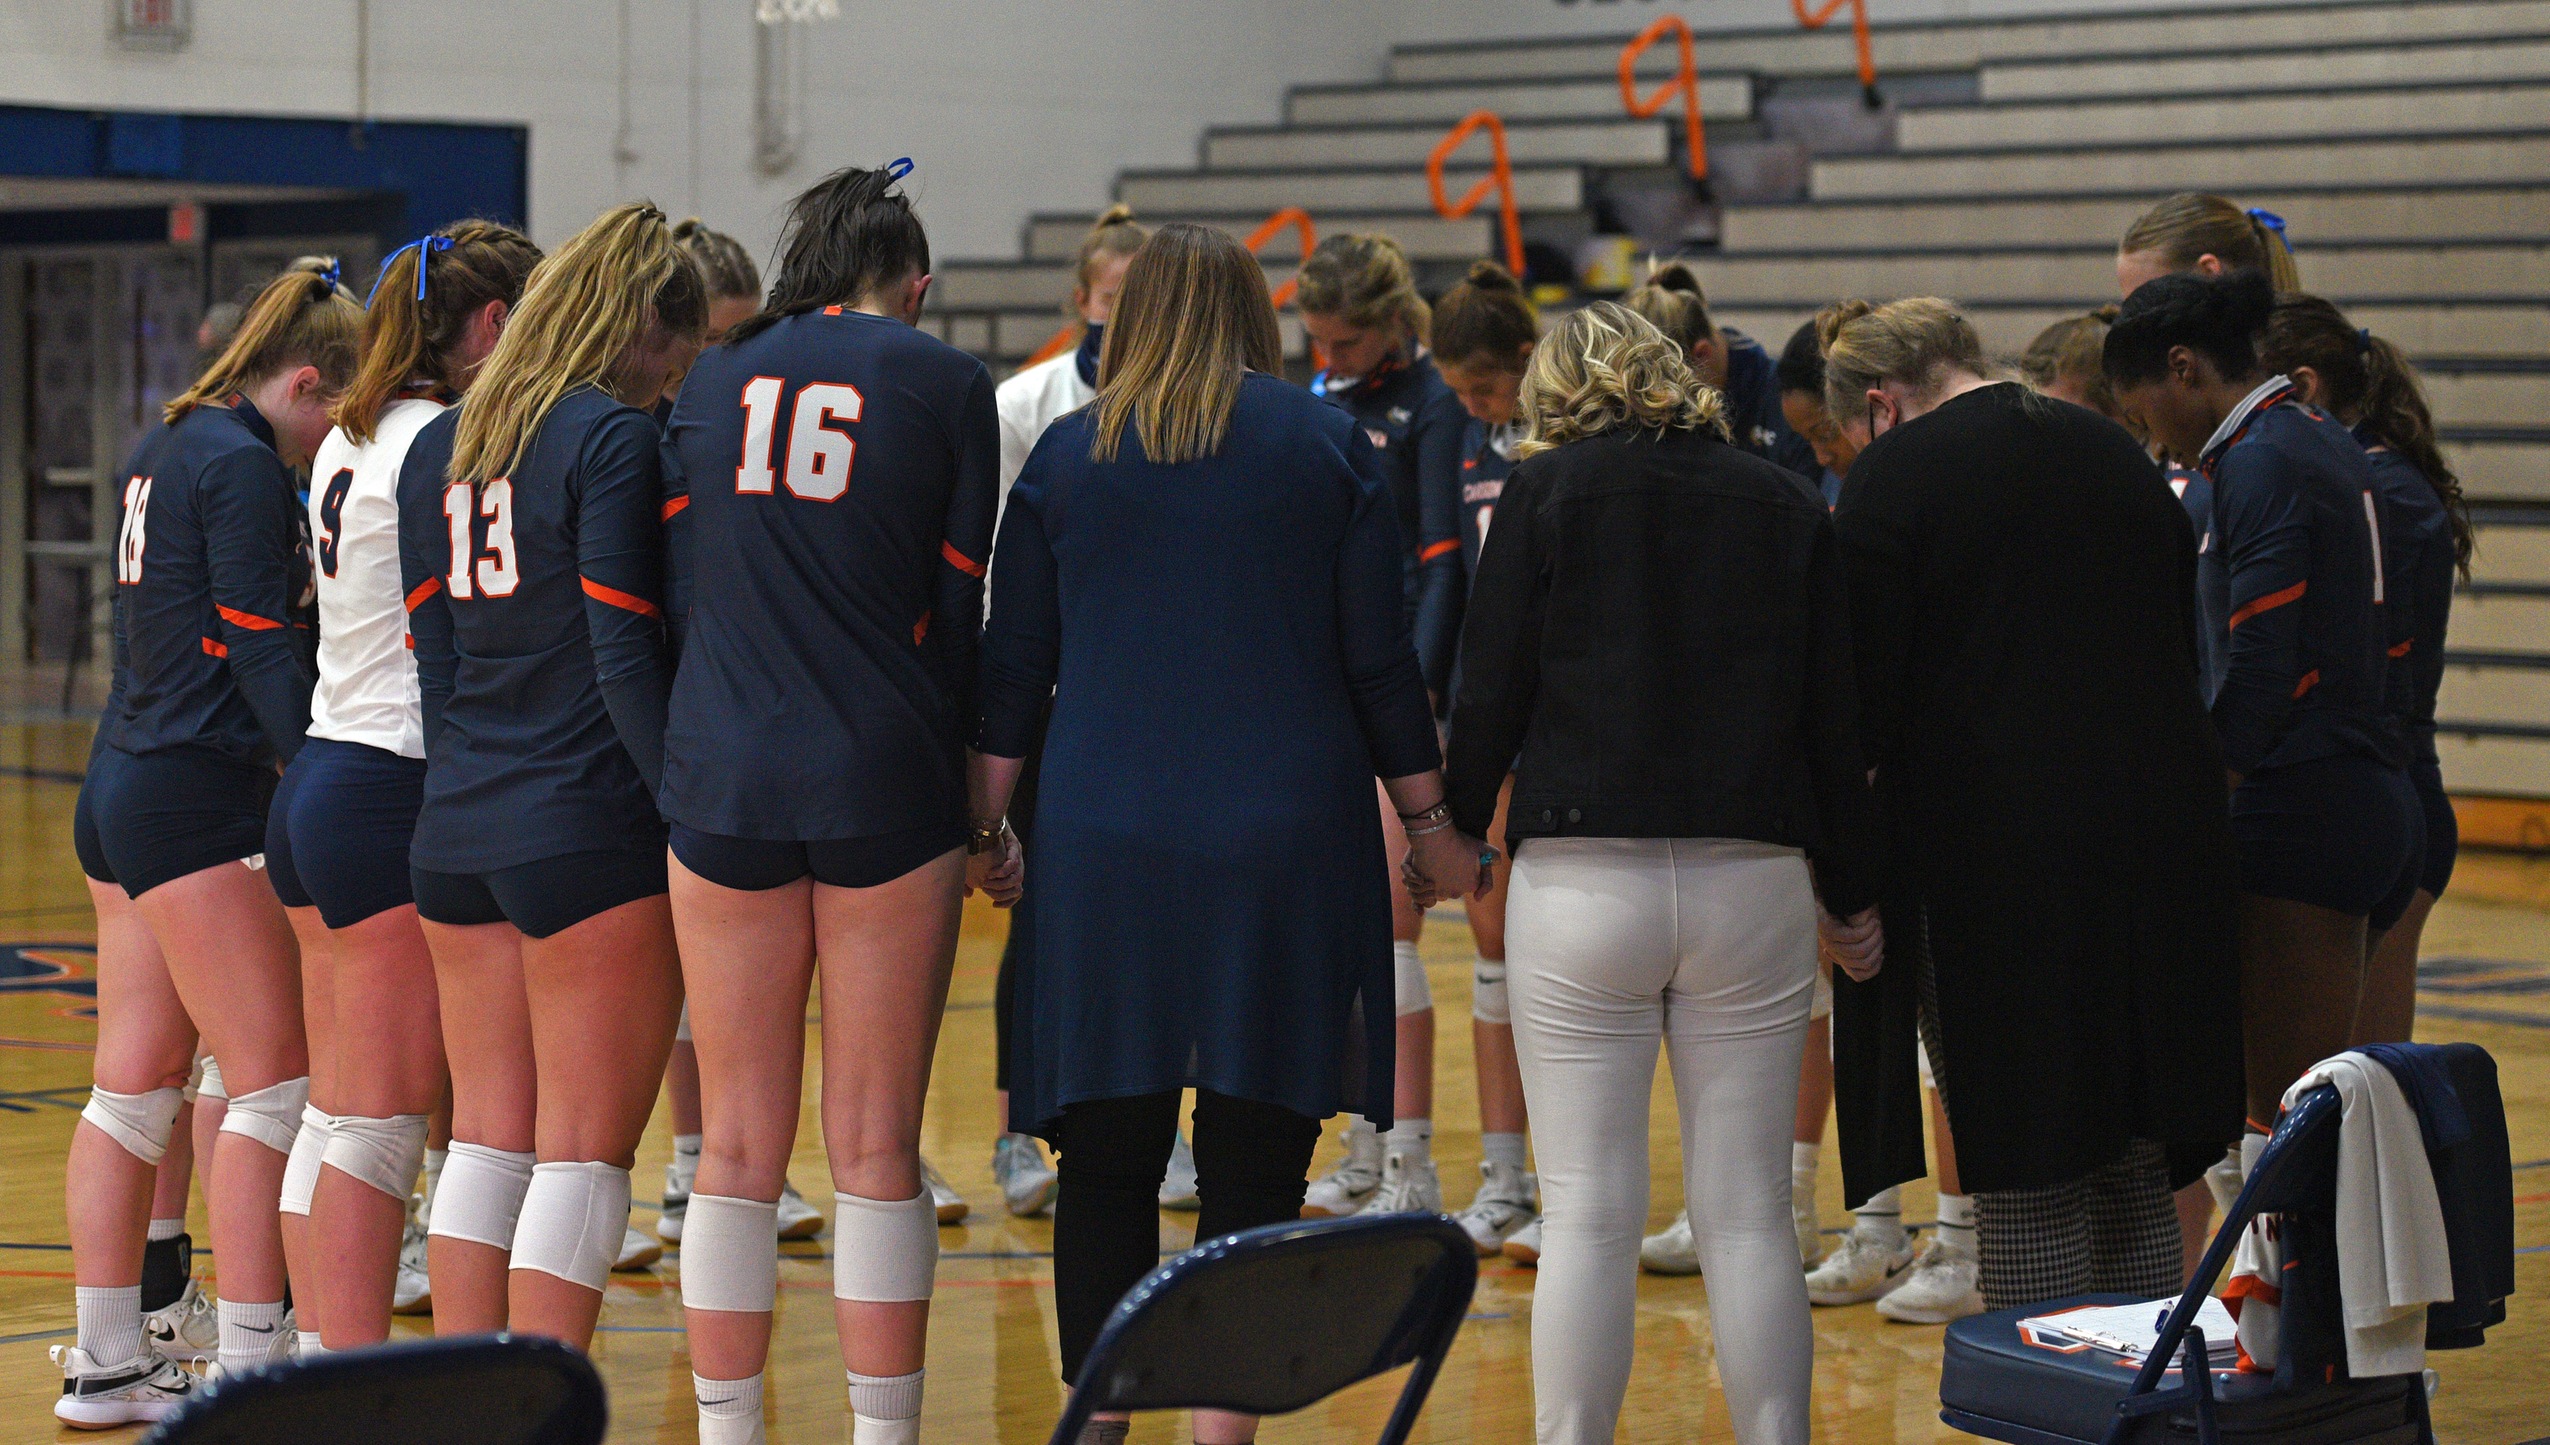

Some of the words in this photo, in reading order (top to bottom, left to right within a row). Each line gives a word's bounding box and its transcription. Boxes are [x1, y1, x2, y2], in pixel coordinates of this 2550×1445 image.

[735, 375, 864, 503] 16
[319, 467, 355, 579] 9
[443, 477, 521, 600] 13
